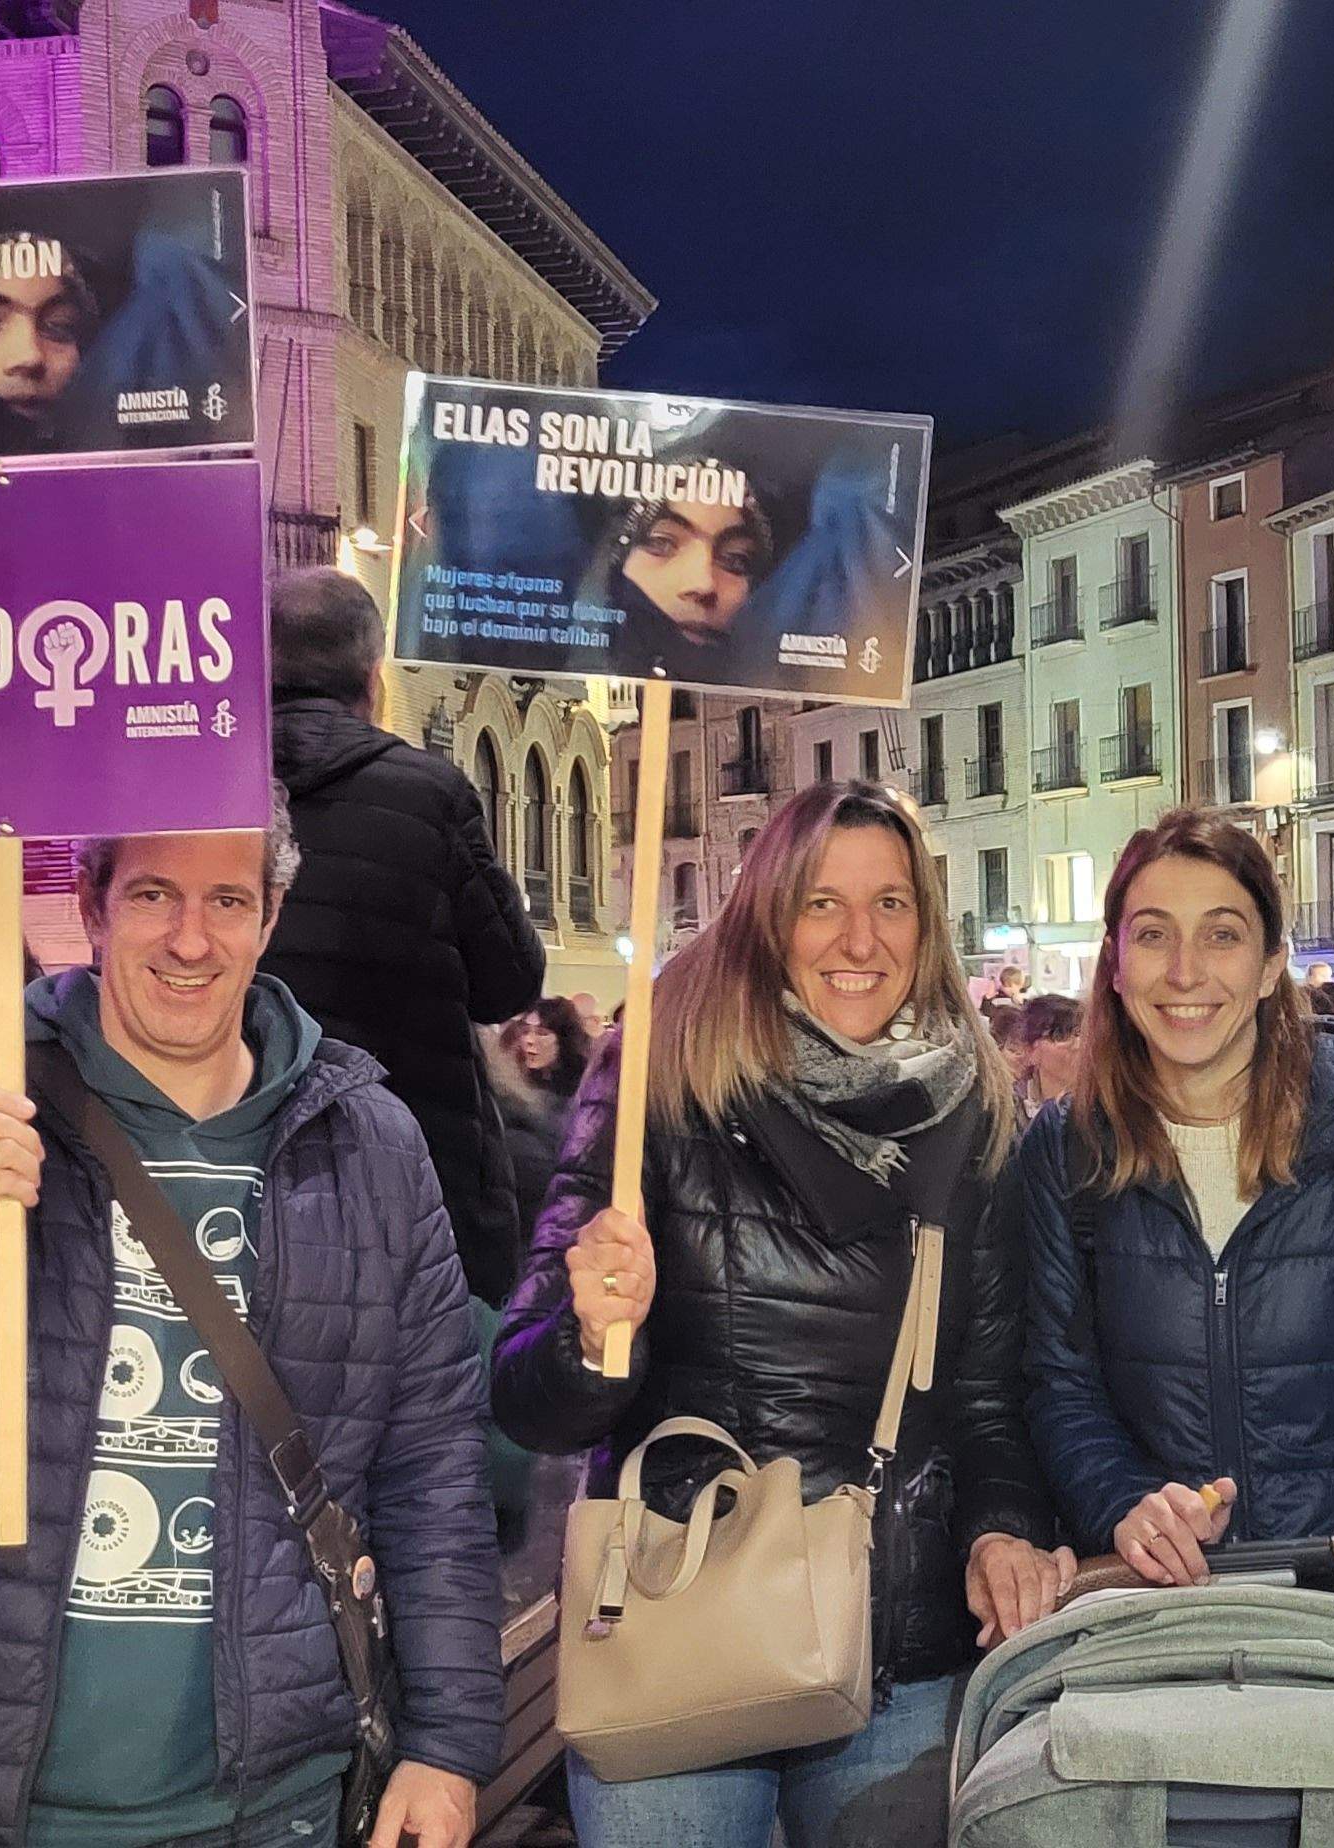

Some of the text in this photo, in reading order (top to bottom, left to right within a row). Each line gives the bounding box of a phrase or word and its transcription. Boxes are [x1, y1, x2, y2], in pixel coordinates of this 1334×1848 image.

[118, 385, 189, 411] AMNISTÍA
[118, 409, 190, 424] INTERNACIONAL
[434, 402, 653, 458] ELLAS SON LA
[535, 456, 746, 507] REVOLUCIÓN
[427, 565, 494, 588] Mujeres
[425, 593, 455, 611] que
[518, 602, 547, 619] por
[550, 604, 569, 619] su
[423, 614, 459, 638] bajo
[461, 618, 478, 636] el
[127, 700, 199, 724] AMNISTÍA
